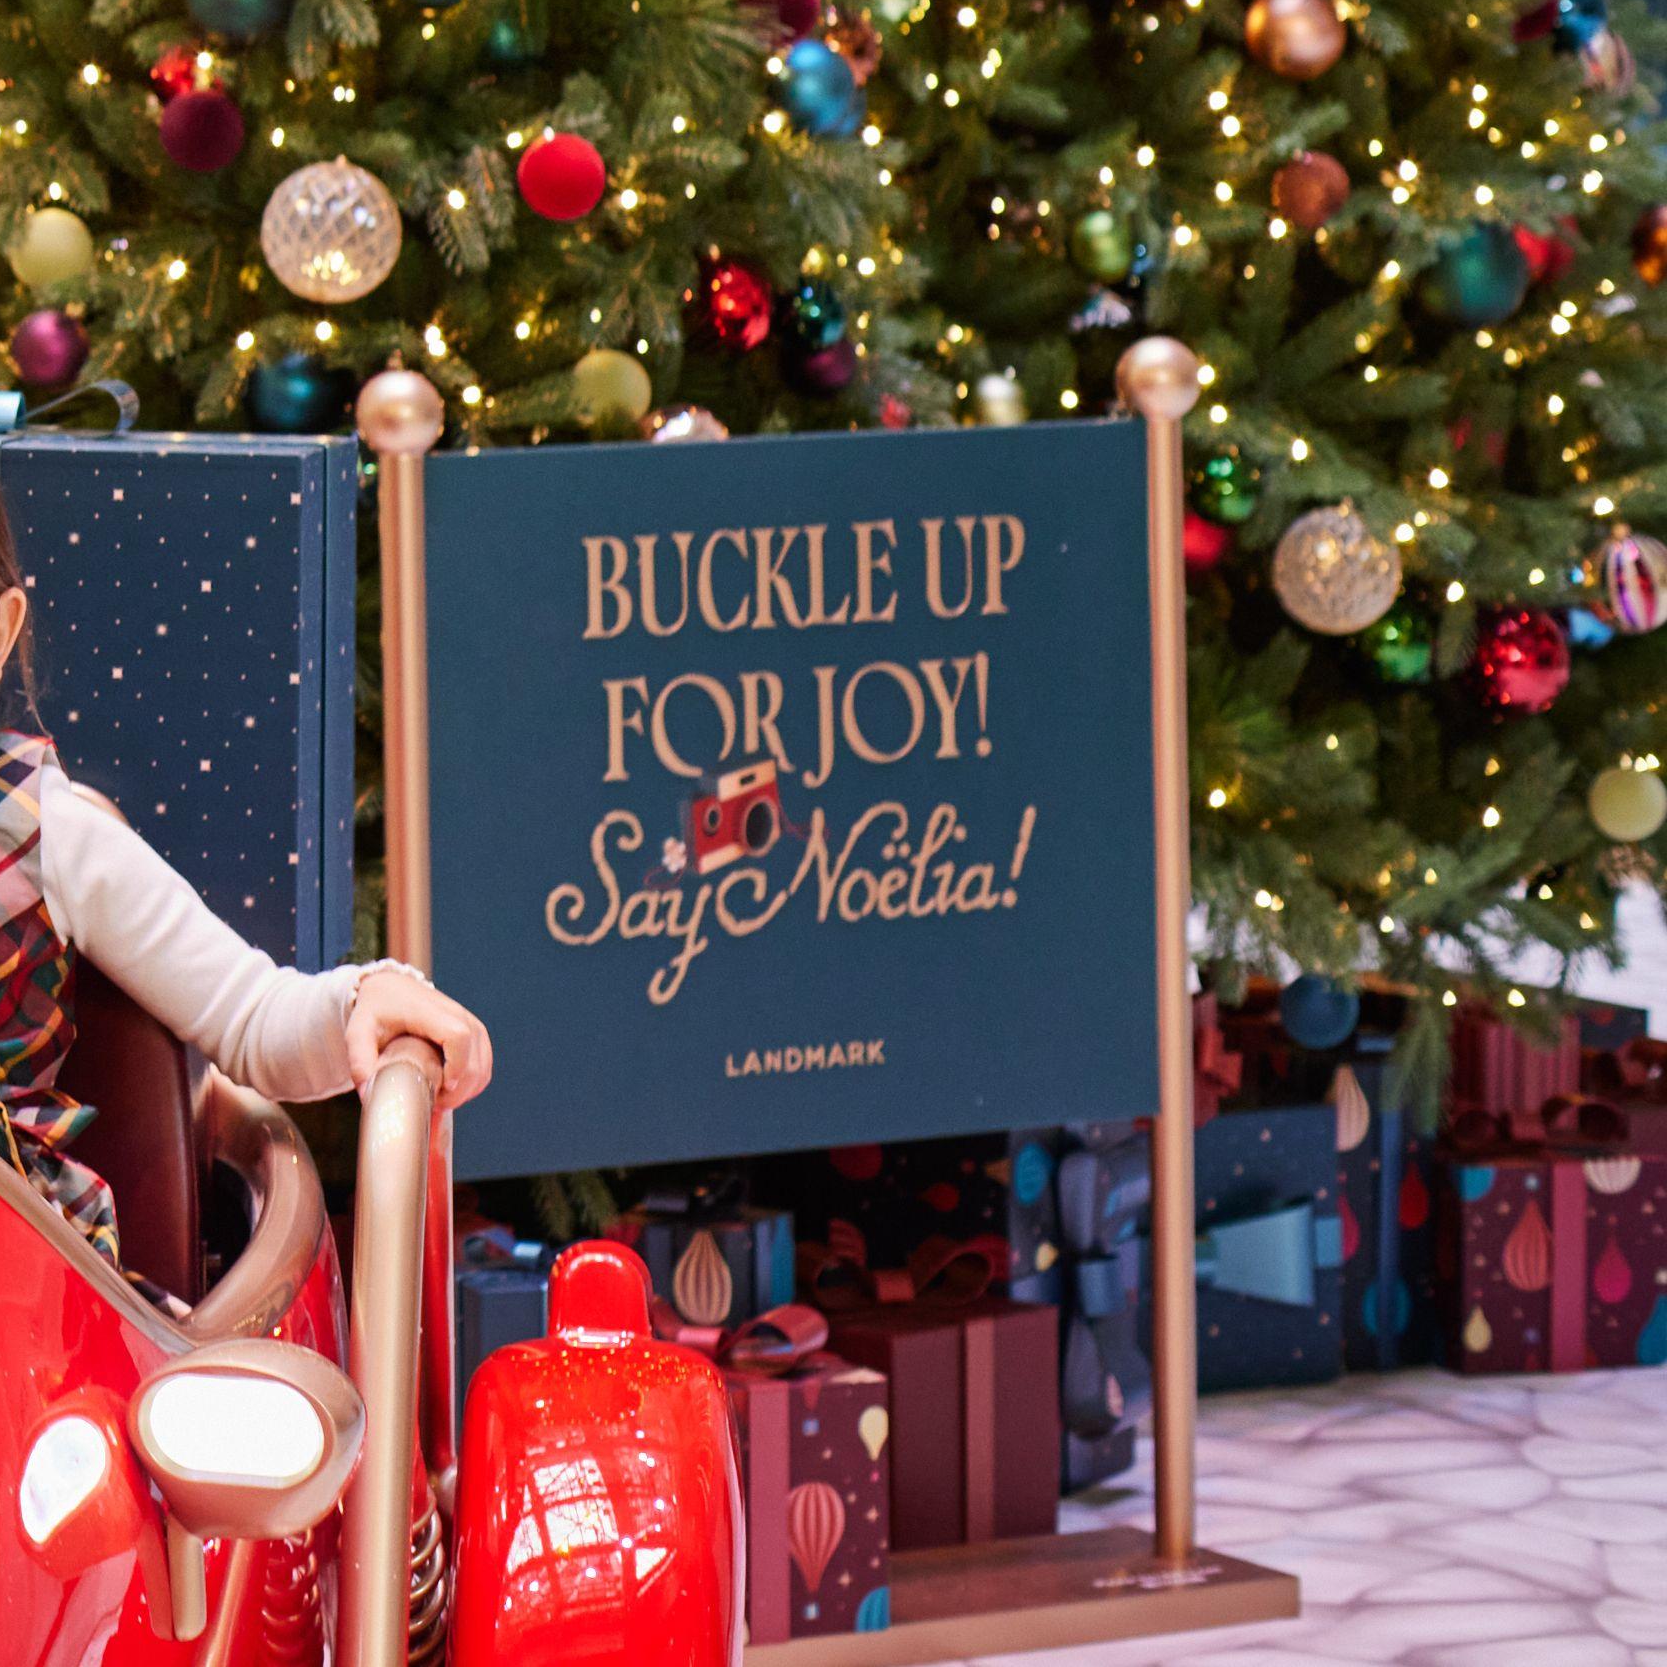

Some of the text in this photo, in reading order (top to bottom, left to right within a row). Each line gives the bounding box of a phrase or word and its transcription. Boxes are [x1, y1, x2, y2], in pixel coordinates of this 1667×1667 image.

[582, 514, 1025, 640] BUCKLE UP
[603, 651, 992, 788] FOR JOY!
[545, 801, 1036, 1005] Say Noëlia!
[725, 1039, 885, 1078] LANDMARK
